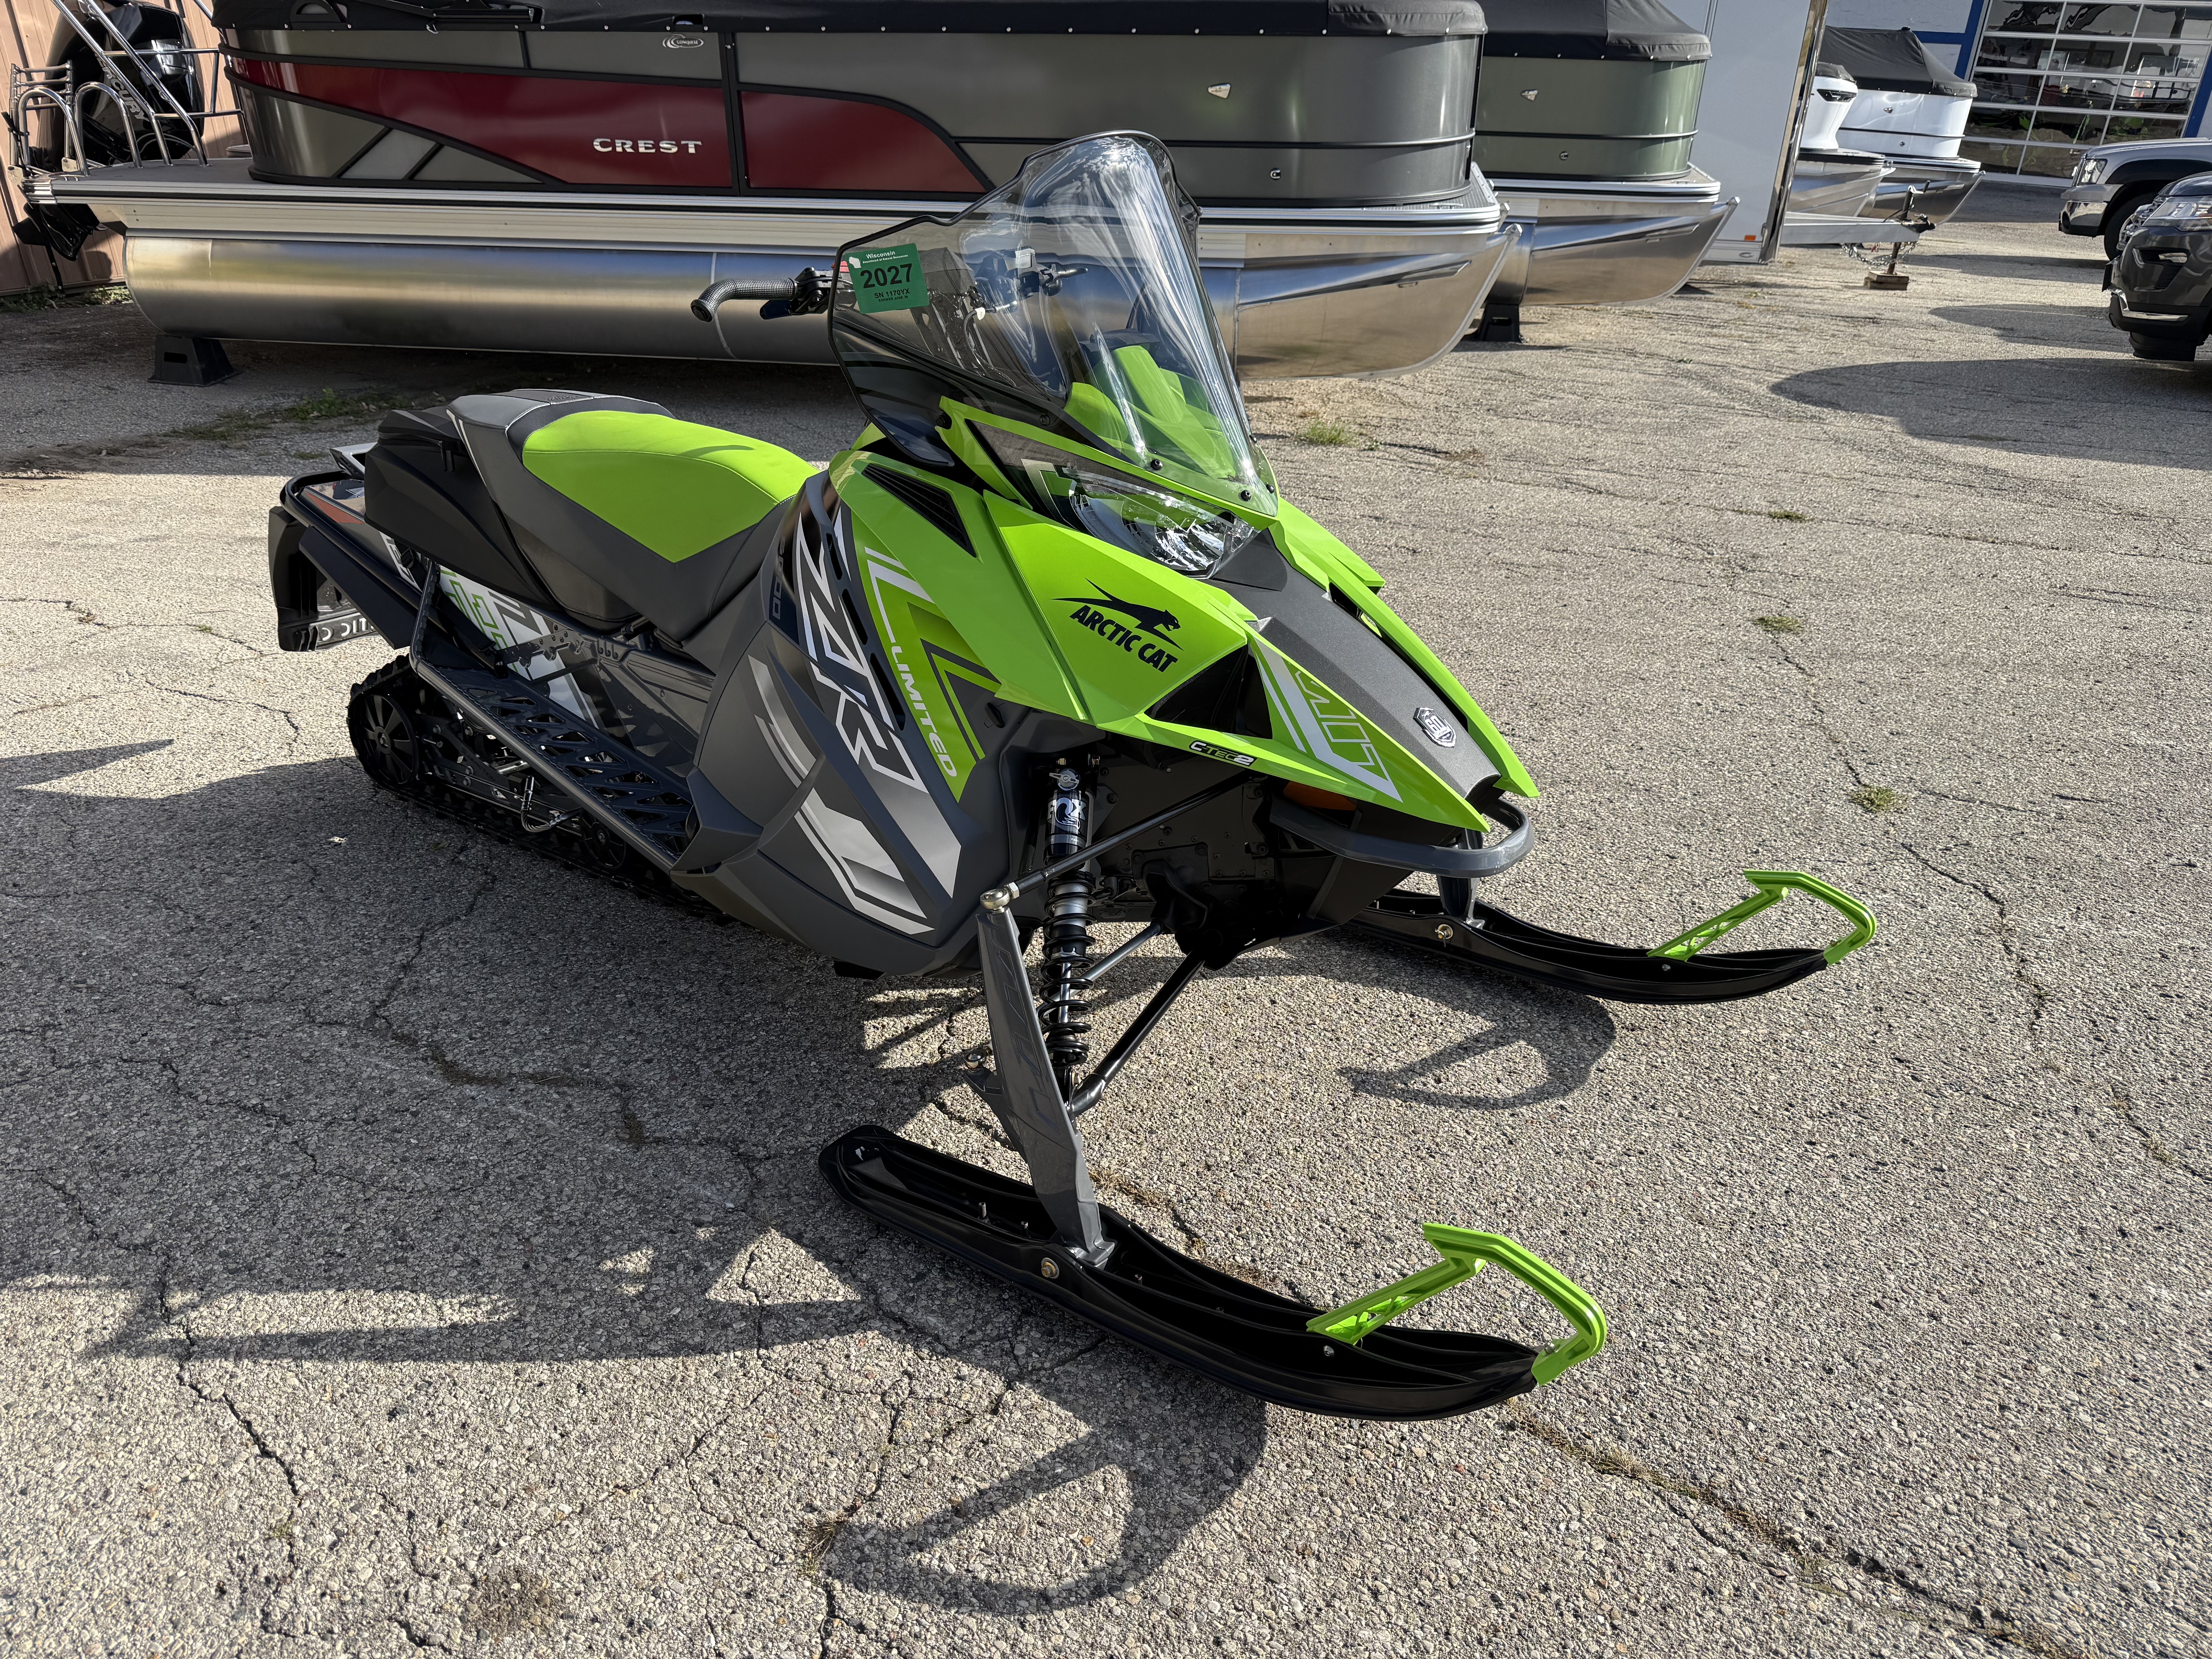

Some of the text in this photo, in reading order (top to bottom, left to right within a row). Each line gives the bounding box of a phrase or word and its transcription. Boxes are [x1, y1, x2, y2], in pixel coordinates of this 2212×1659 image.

[94, 53, 150, 122] ERCURY
[593, 138, 702, 154] CREST
[866, 251, 896, 259] Wisconsin
[860, 263, 912, 289] 2027
[886, 288, 910, 297] 1170YX
[1070, 605, 1179, 673] ARCTIC CAT
[891, 644, 958, 778] LIMITED
[1190, 741, 1254, 766] C-TEC2
[1047, 797, 1087, 830] FOX
